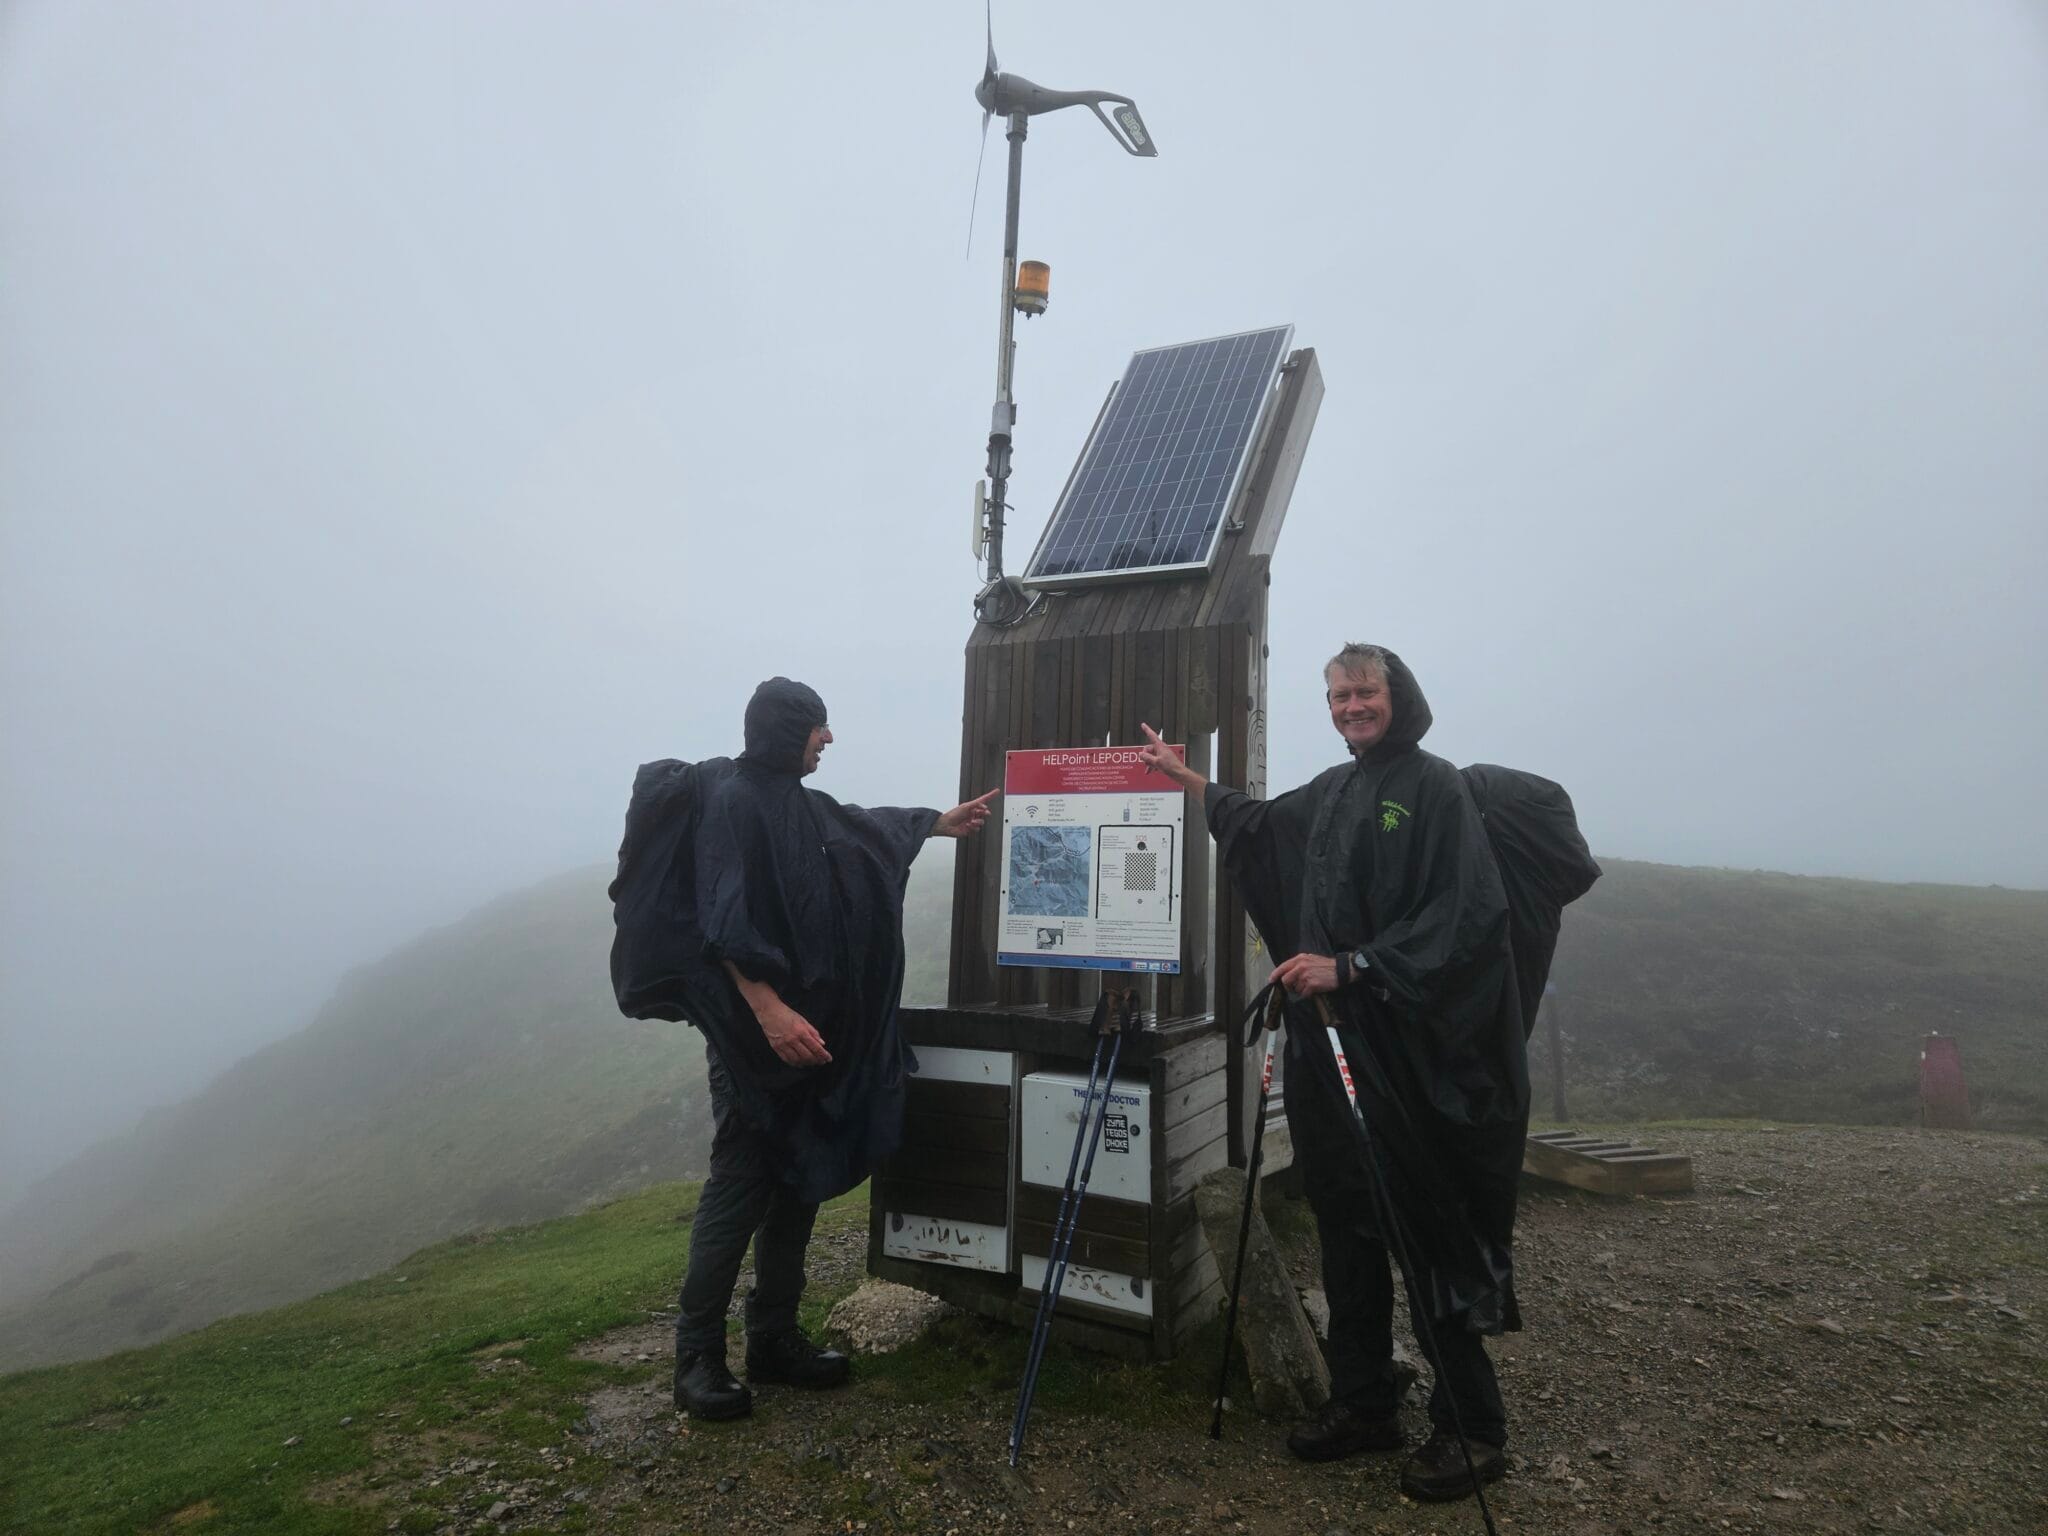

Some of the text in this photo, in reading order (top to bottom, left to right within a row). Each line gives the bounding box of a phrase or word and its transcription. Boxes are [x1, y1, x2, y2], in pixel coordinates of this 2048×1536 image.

[1043, 751, 1145, 766] HELPoint LEPOEDE
[1336, 1053, 1357, 1096] LEKI
[1072, 1088, 1088, 1099] THE
[1109, 1094, 1141, 1106] DOCTOR
